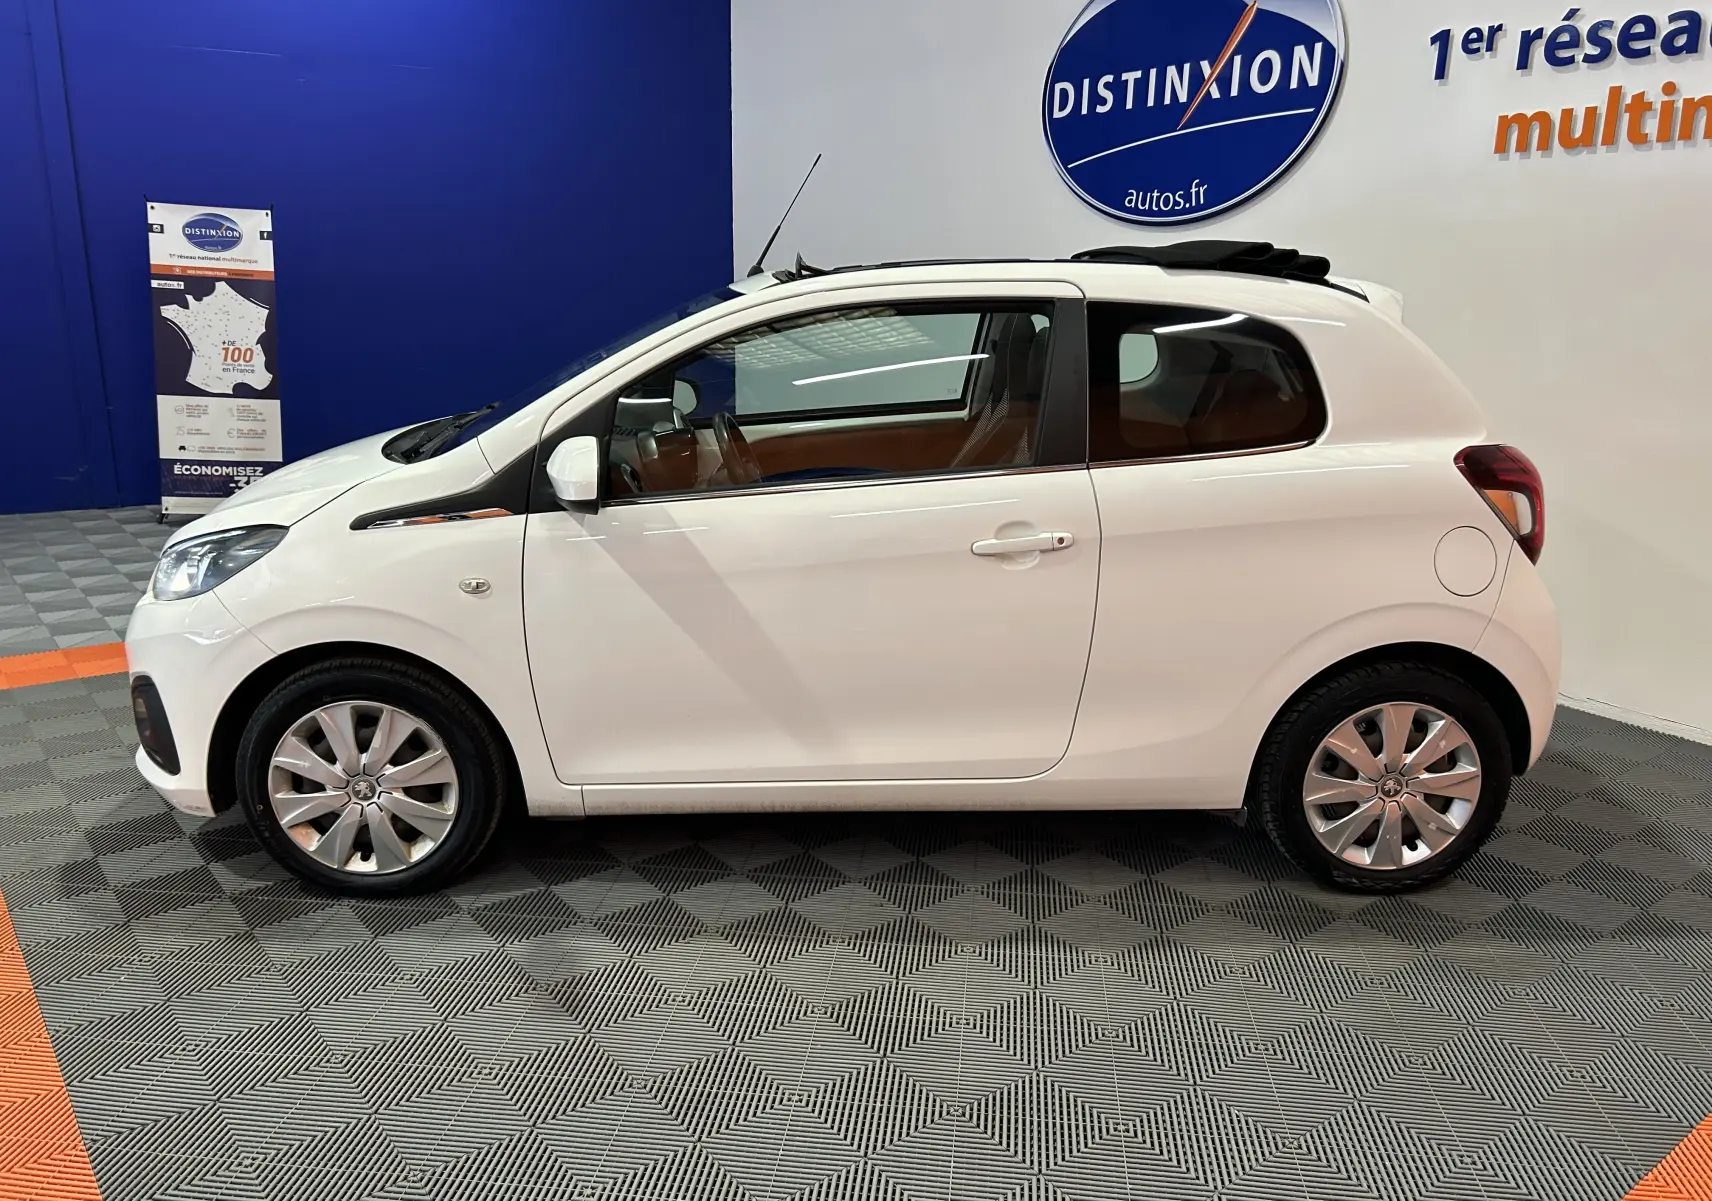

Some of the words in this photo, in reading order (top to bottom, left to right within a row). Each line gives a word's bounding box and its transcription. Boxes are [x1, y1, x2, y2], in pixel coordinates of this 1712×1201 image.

[1516, 8, 1712, 70] résea
[1052, 41, 1324, 119] DISTINXION
[1124, 178, 1208, 211] autos.fr
[184, 227, 240, 238] DISTINXION
[222, 346, 254, 363] 100
[173, 462, 264, 476] ÉCONOMISEZ
